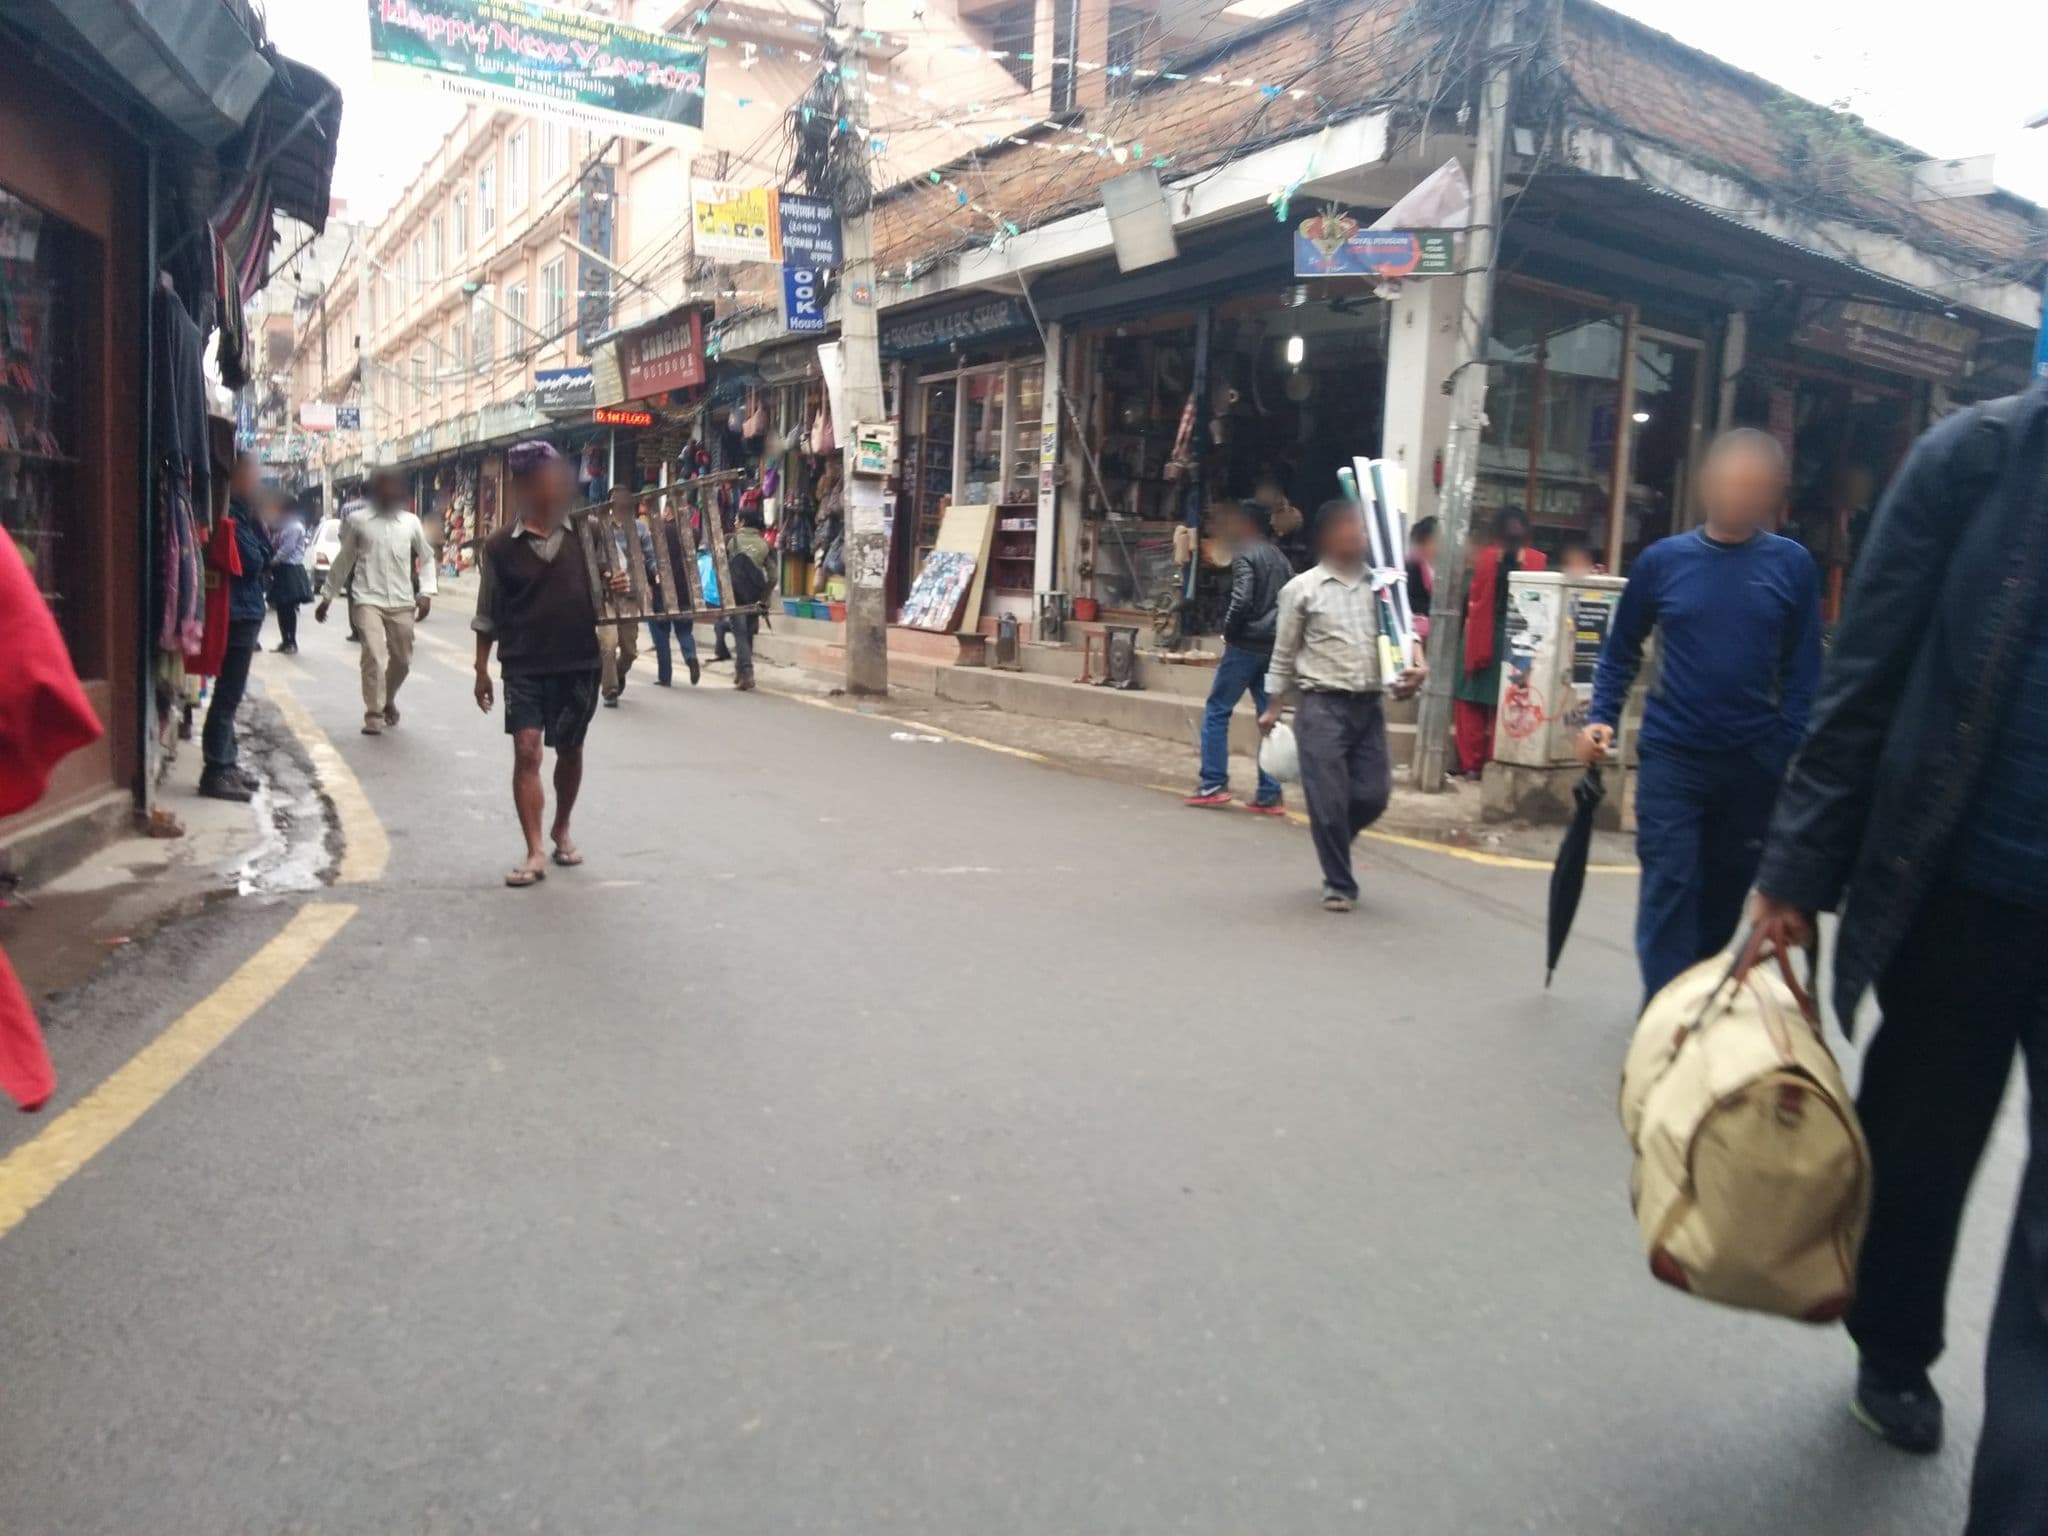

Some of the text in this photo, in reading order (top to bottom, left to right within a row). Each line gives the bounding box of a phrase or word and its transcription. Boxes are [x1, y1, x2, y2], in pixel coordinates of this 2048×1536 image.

[492, 8, 508, 21] the
[380, 0, 490, 53] Happy
[492, 22, 569, 63] New
[571, 41, 645, 79] Year
[514, 77, 577, 101] President
[441, 79, 487, 100] Thamel
[491, 88, 540, 109] Tourism
[542, 101, 618, 126] Development
[790, 316, 824, 329] House
